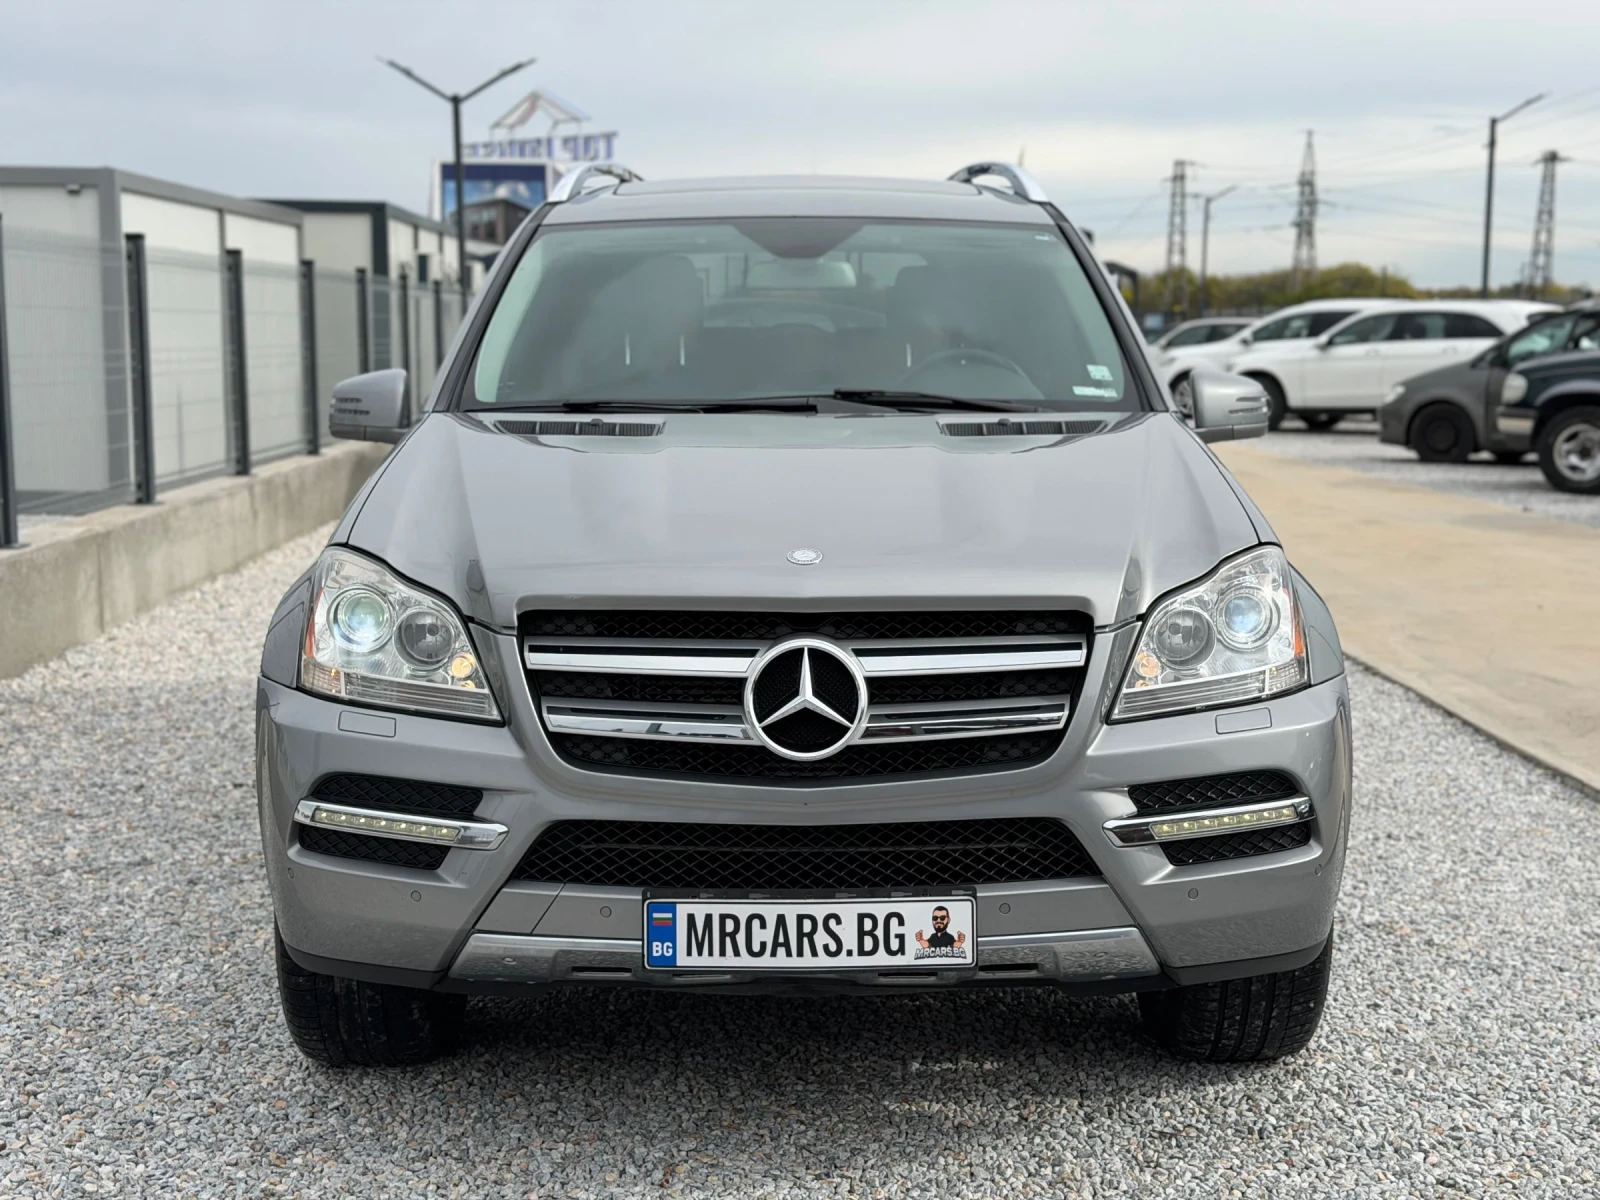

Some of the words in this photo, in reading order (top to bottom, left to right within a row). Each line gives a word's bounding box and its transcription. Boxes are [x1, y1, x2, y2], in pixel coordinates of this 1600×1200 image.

[686, 912, 905, 958] MRCARS.BG
[652, 942, 673, 957] BG
[914, 946, 967, 960] MRCARS.BG
